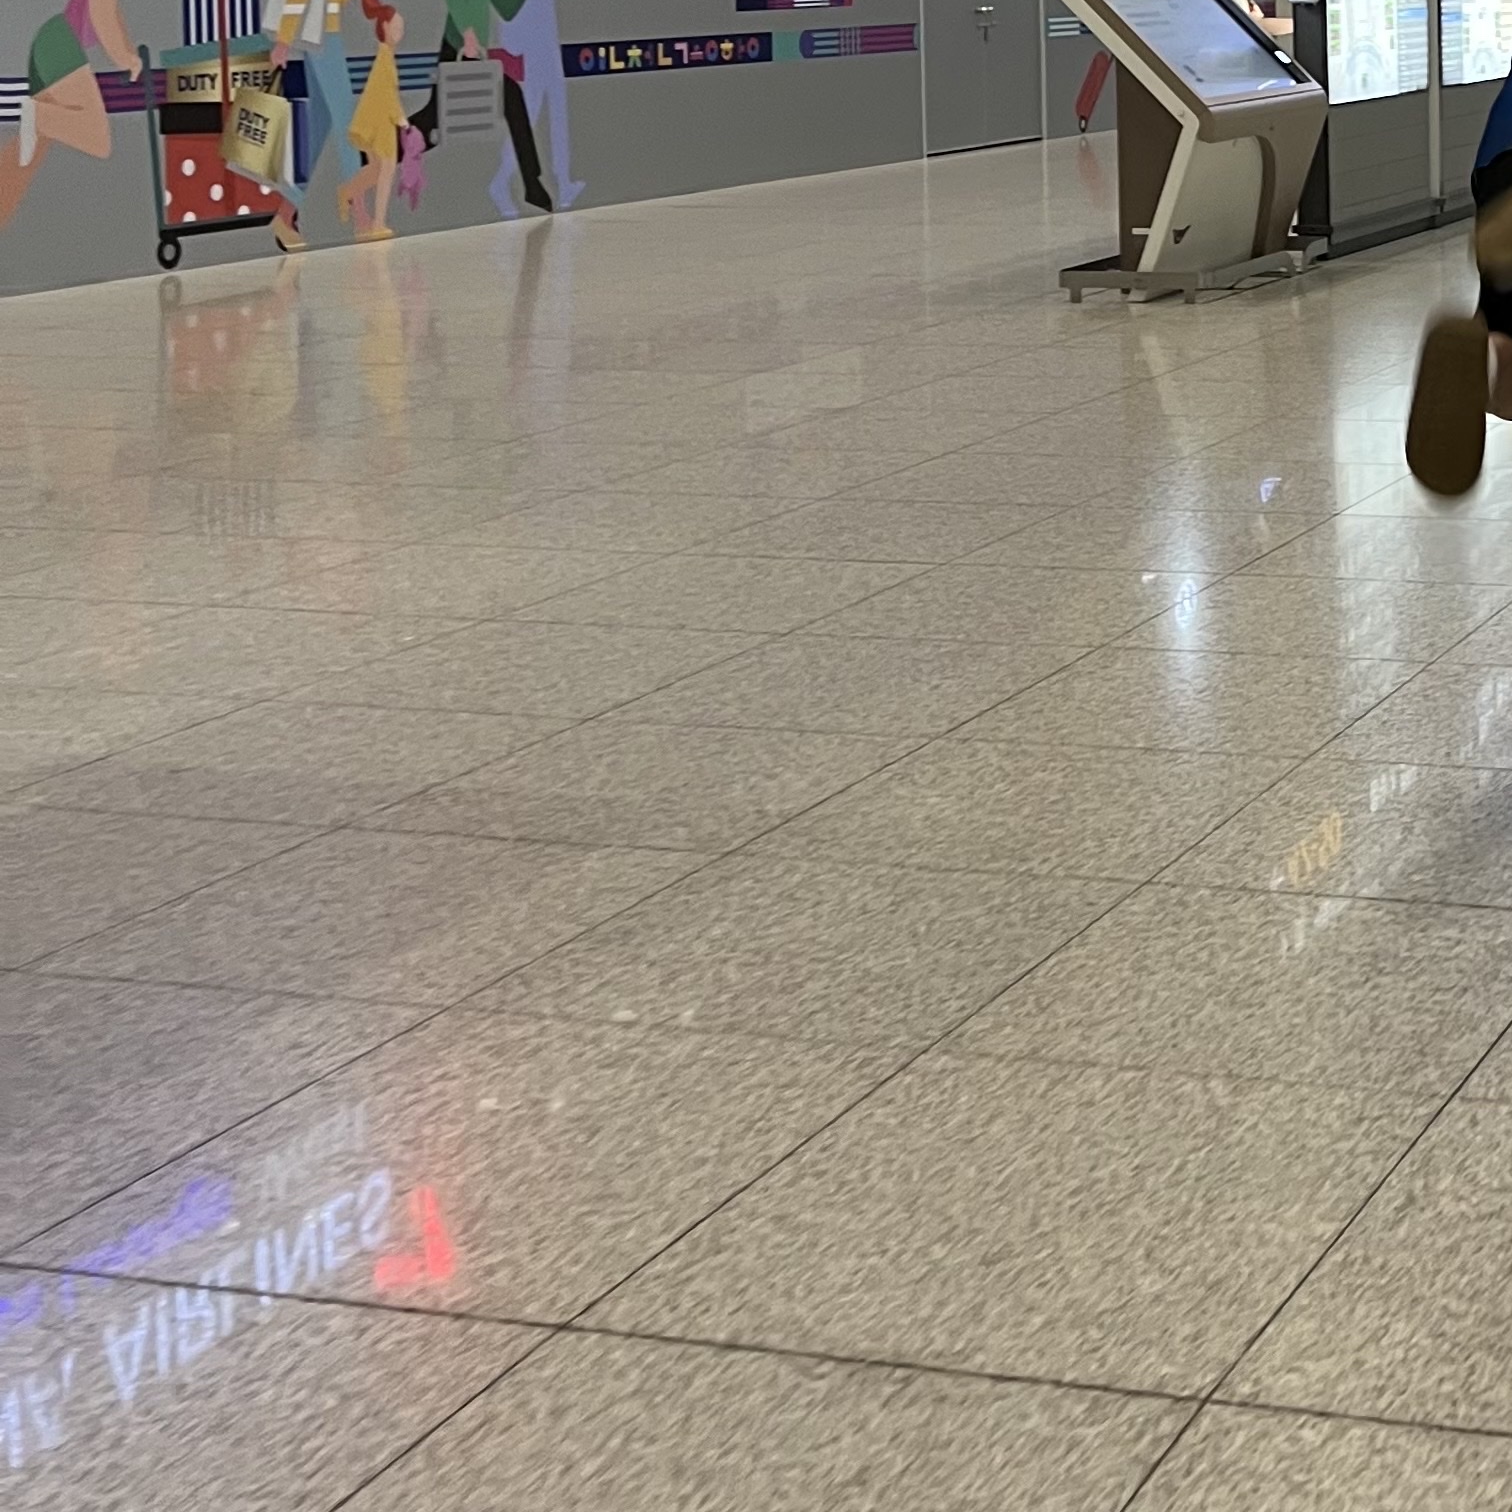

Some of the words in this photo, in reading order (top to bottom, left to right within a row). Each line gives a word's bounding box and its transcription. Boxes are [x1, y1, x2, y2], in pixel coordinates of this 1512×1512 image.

[177, 73, 219, 93] DUTY
[231, 70, 273, 89] FREE
[239, 107, 270, 129] DUTY
[237, 121, 268, 146] FREE
